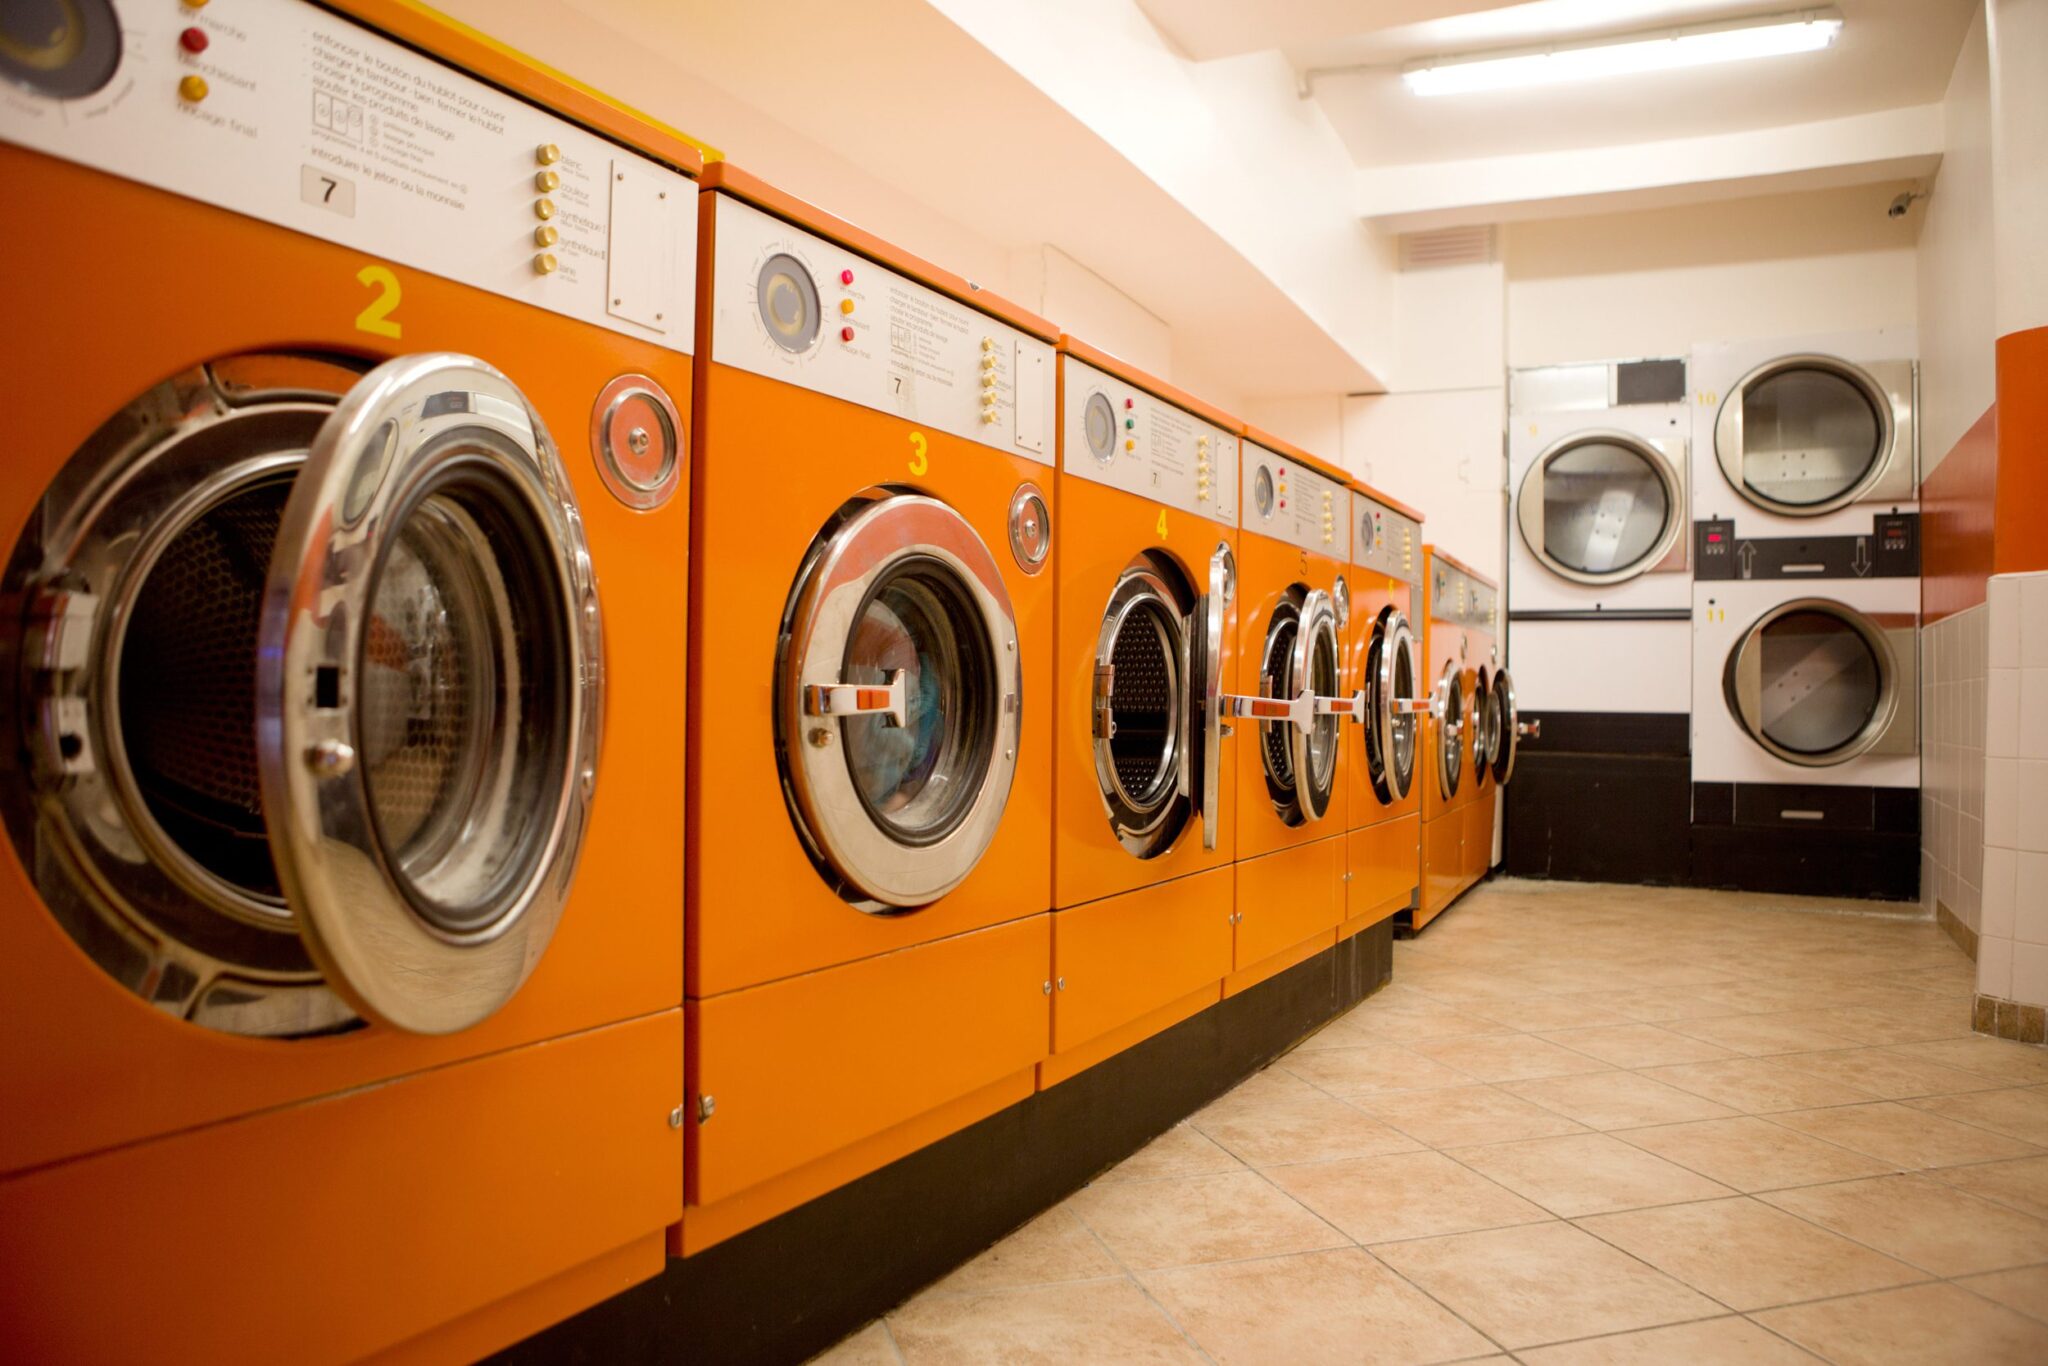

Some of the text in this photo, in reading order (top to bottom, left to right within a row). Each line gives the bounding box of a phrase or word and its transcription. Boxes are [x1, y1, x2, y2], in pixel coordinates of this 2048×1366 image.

[321, 177, 337, 203] 7
[356, 265, 402, 340] 2
[894, 377, 902, 394] 7
[908, 431, 928, 476] 3
[1156, 508, 1168, 540] 4
[1706, 607, 1725, 624] 11
